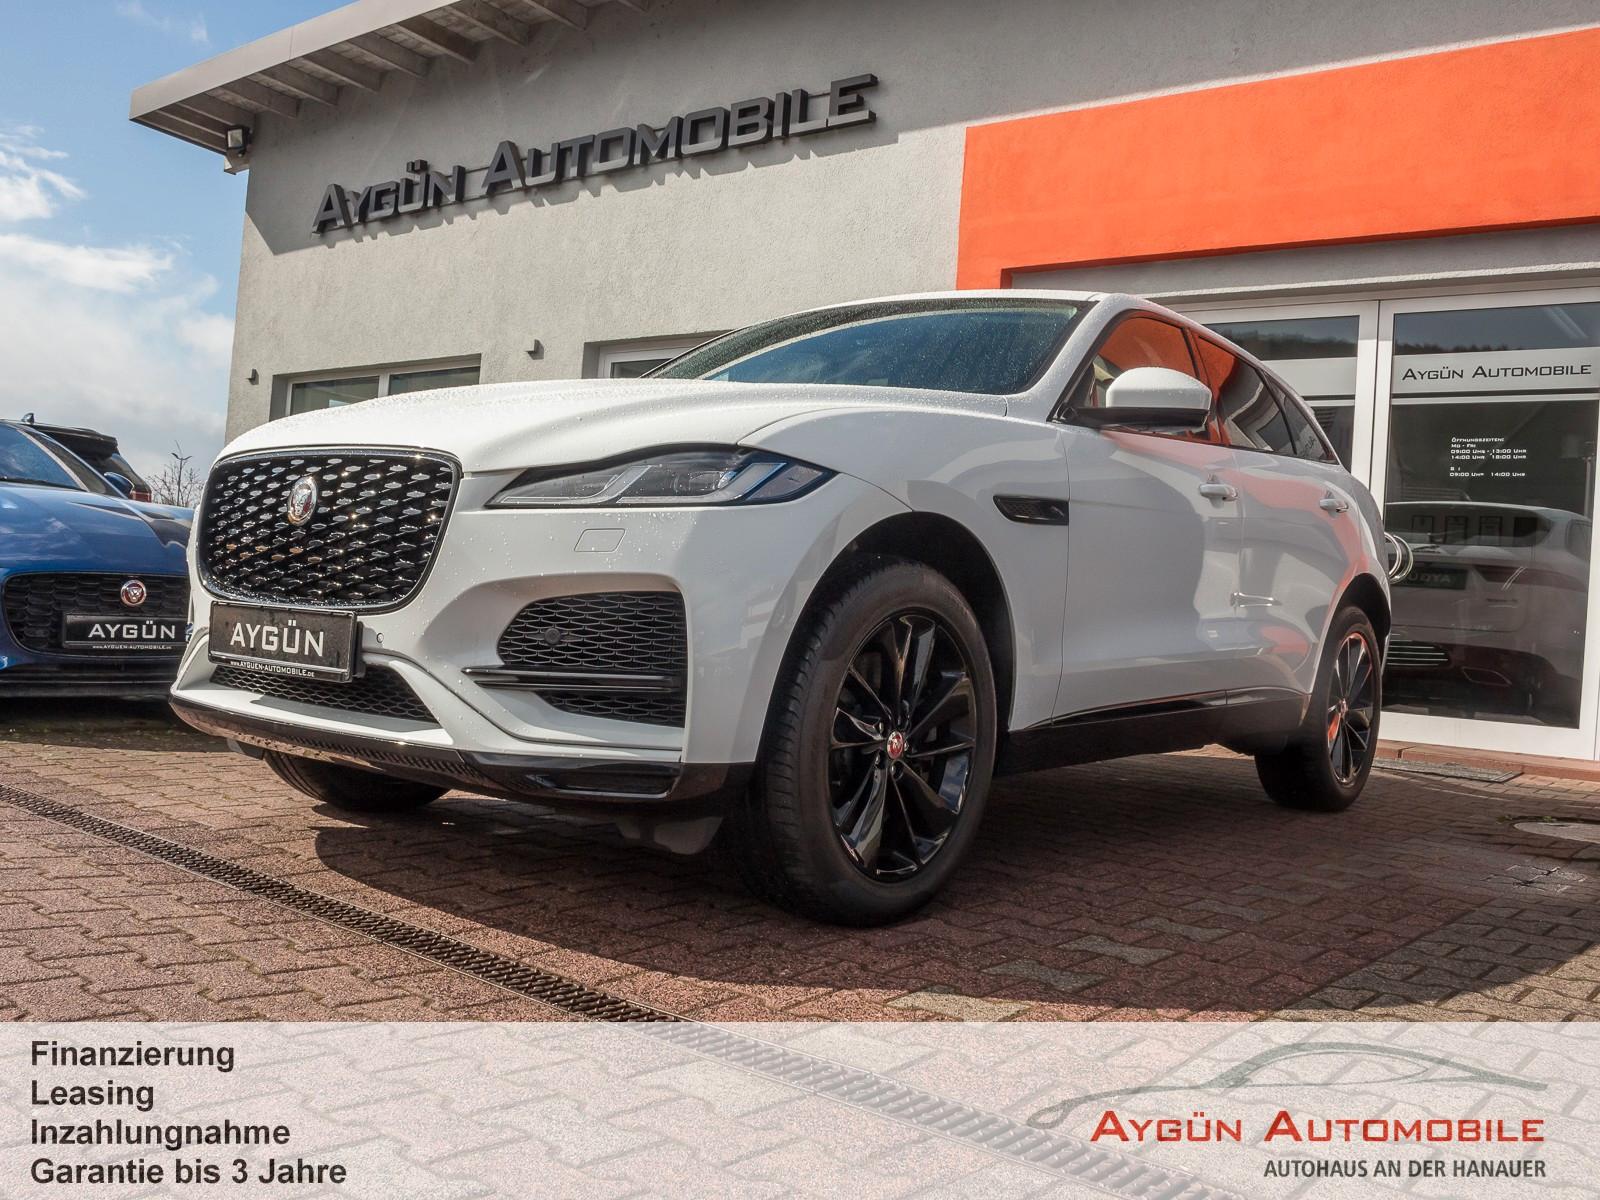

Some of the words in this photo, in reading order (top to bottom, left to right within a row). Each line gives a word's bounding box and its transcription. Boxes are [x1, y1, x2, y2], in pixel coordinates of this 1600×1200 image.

[312, 159, 466, 234] AYGÜN
[482, 73, 879, 197] AUTOMOBILE
[1402, 366, 1464, 380] AYGÜN
[1472, 365, 1592, 379] AUTOMOBILE
[88, 620, 176, 639] AYGÜN
[229, 619, 325, 658] AYGÜN
